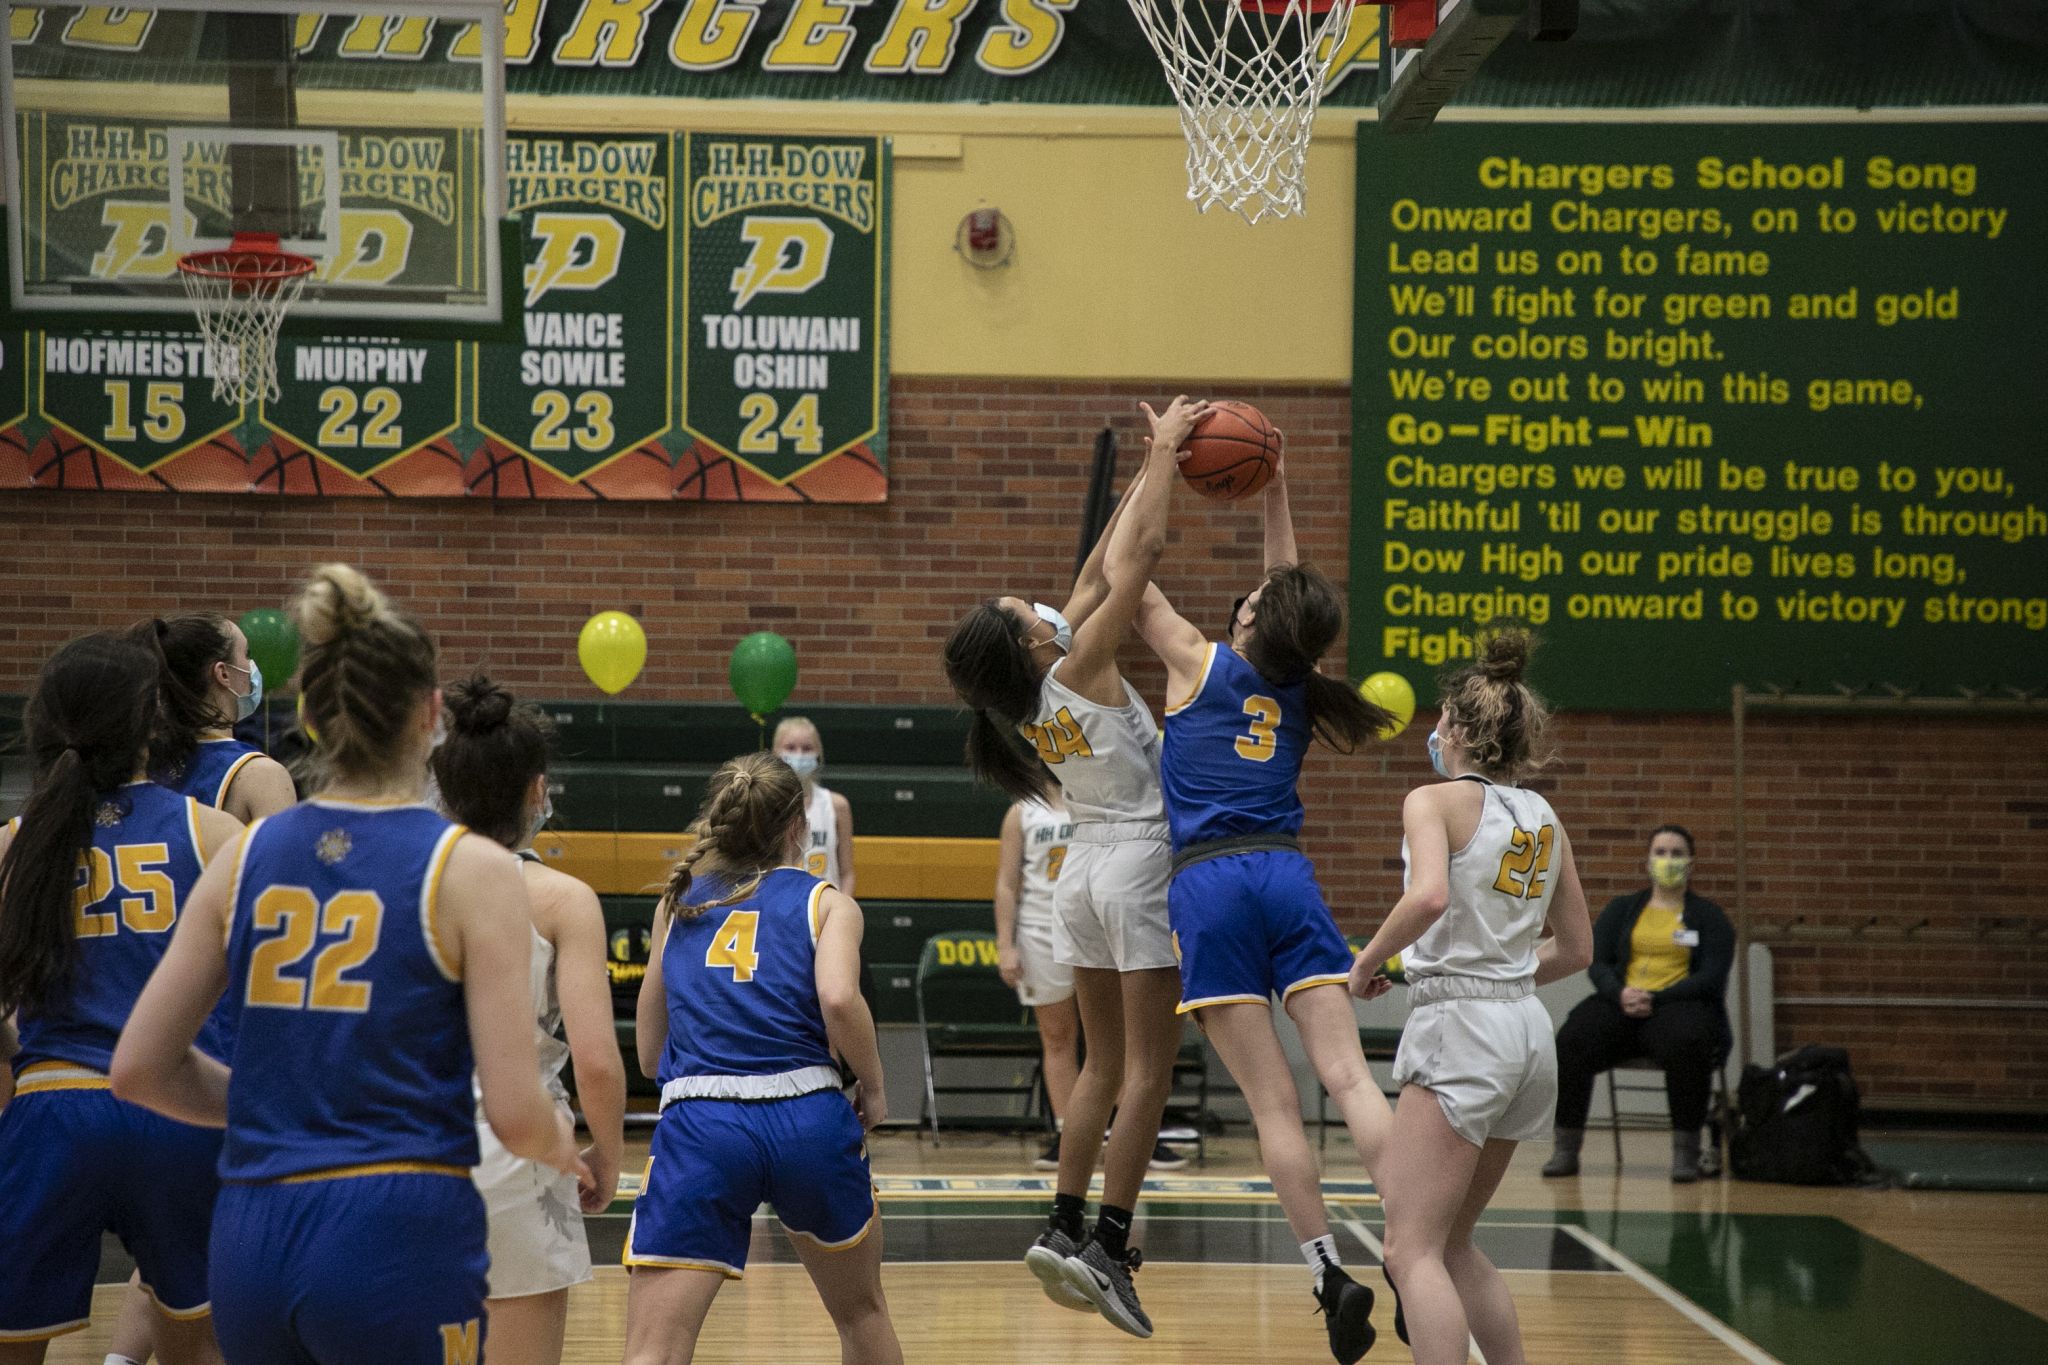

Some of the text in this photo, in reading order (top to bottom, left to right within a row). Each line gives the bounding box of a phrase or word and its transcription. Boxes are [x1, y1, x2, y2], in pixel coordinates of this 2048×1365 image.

[362, 138, 441, 170] DOW
[576, 145, 654, 175] DOW
[785, 149, 861, 178] DOW
[1479, 157, 1976, 196] Chargers School Song
[507, 176, 664, 226] HARGERS
[695, 180, 871, 230] CHARGERS
[1391, 199, 2006, 239] Onward Chargers, on to victory
[1389, 242, 1769, 275] Lead us on to fame
[1492, 285, 1575, 324] fight
[1593, 287, 1647, 318] for
[1663, 294, 1770, 325] green
[1788, 288, 1857, 318] and
[1876, 288, 1958, 325] gold
[524, 313, 624, 347] VANCE
[703, 315, 861, 352] TOLUWANI
[1388, 326, 1723, 367] Our colors bright.
[296, 346, 428, 384] MURPHY
[521, 352, 626, 387] SOWLE
[733, 356, 829, 389] OSHIN
[104, 379, 187, 443] 15
[1509, 372, 1568, 402] out
[1587, 373, 1625, 403] to
[1642, 372, 1704, 402] win
[1722, 372, 1789, 404] this
[1808, 380, 1922, 411] game,
[318, 387, 403, 448] 22
[530, 390, 615, 452] 23
[738, 394, 823, 454] 24
[1386, 455, 2013, 497] Chargers we will be true to you,
[1385, 499, 1520, 532] Faithful
[1599, 509, 1659, 533] our
[1678, 504, 1832, 541] struggle
[1852, 504, 1881, 535] is
[1902, 504, 2046, 542] through
[1384, 541, 1965, 584] Dow High our pride lives long,
[1384, 584, 1550, 624] Charging
[1567, 589, 1703, 619] onward
[1721, 591, 1758, 620] to
[1777, 591, 1905, 627] victory
[1234, 694, 1282, 763] 3
[1493, 824, 1555, 900] 22
[74, 843, 177, 939] 25
[246, 885, 384, 1013] 22
[705, 910, 760, 983] 4
